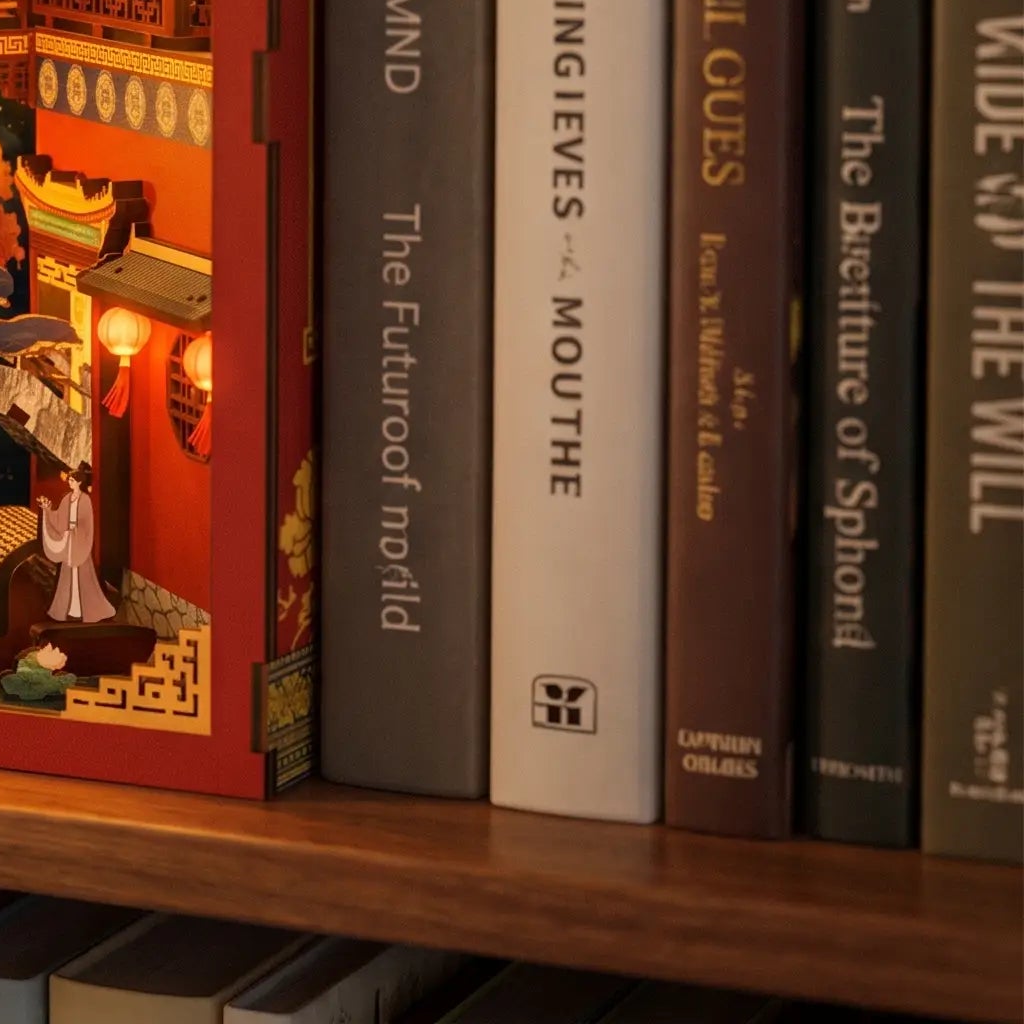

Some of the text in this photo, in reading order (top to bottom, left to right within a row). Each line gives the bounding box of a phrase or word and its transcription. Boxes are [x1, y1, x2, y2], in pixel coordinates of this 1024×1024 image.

[840, 94, 886, 187] The
[380, 203, 422, 286] The
[380, 300, 422, 493] Futuroof
[549, 295, 585, 498] MOUTHE
[835, 416, 881, 475] of
